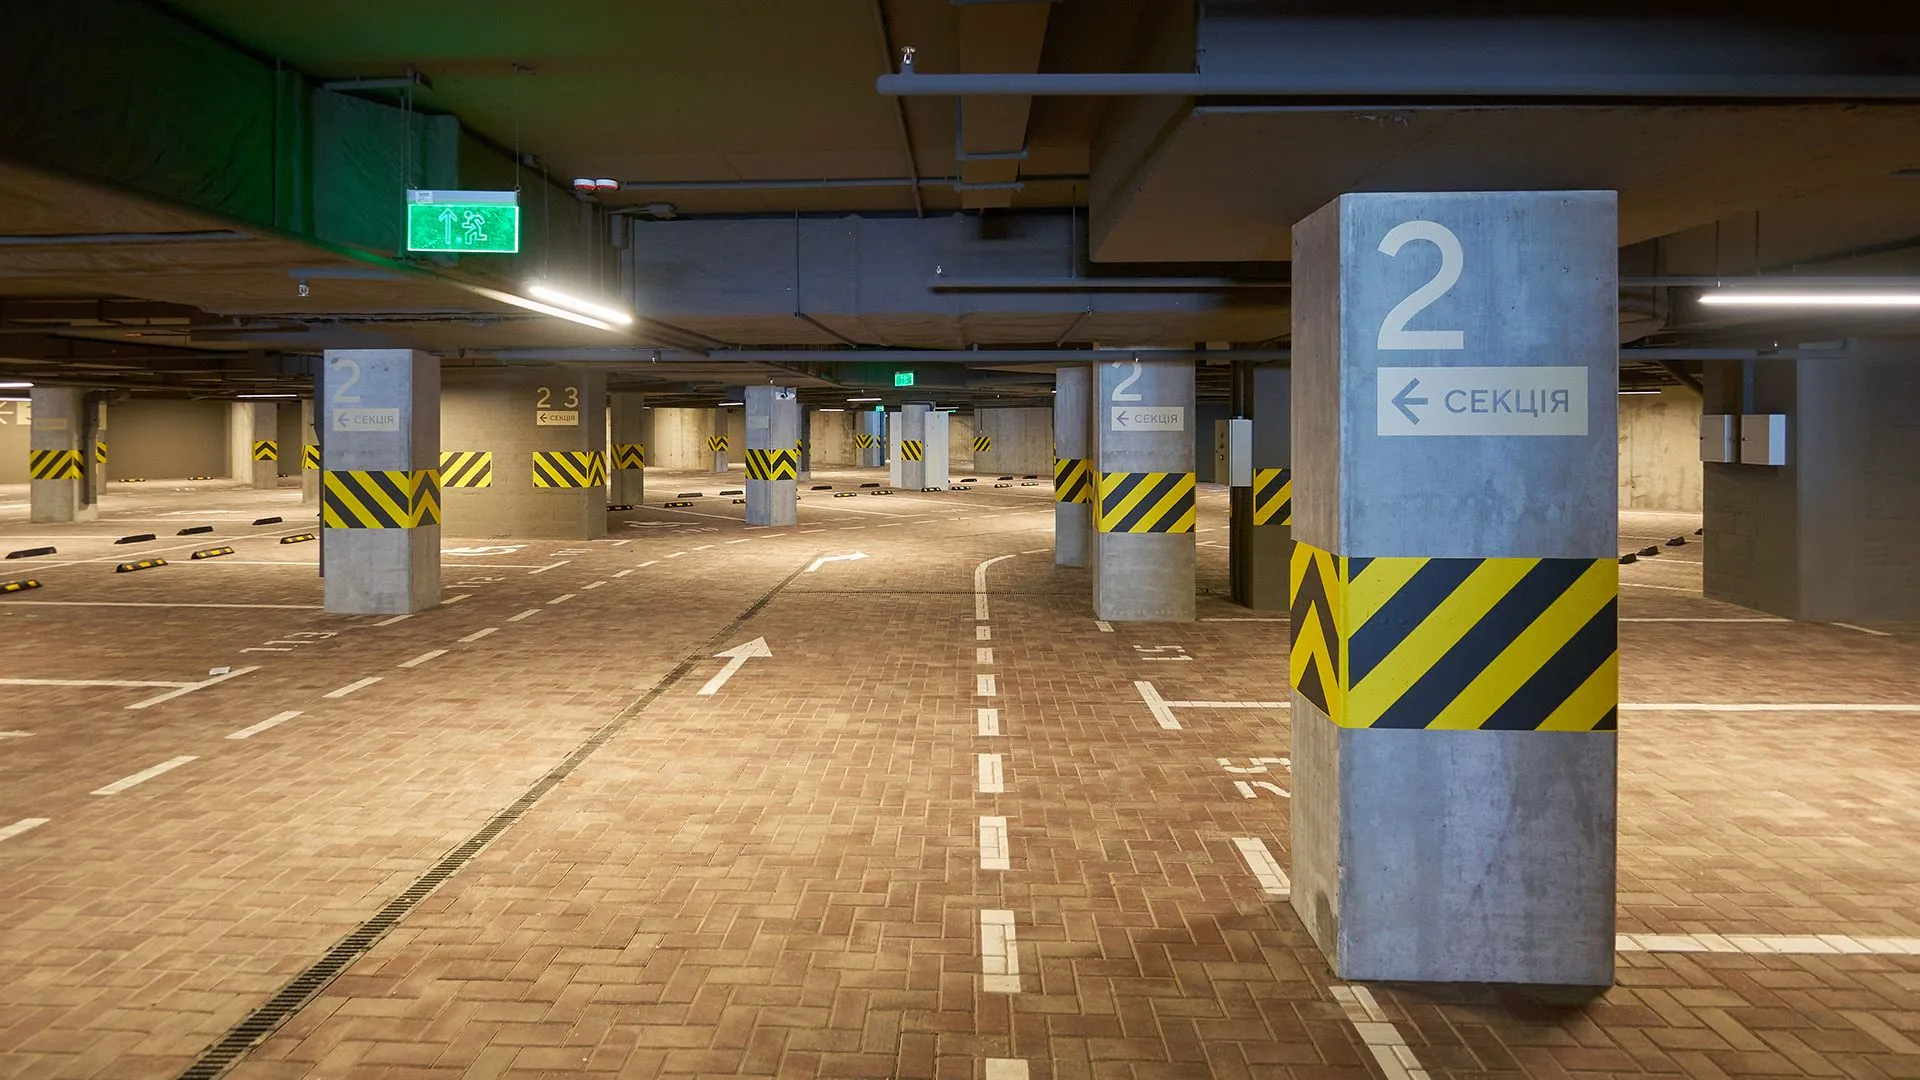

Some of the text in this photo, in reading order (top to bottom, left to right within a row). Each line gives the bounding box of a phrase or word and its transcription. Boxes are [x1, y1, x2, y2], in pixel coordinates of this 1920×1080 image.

[1377, 220, 1464, 350] 2
[332, 358, 362, 403] 2
[1111, 362, 1143, 402] 2
[536, 386, 579, 408] 2 3
[1444, 389, 1569, 417] СЕКЦІЯ
[354, 415, 394, 426] СЕКЦІЯ
[1134, 414, 1178, 425] СЕКЦІЯ
